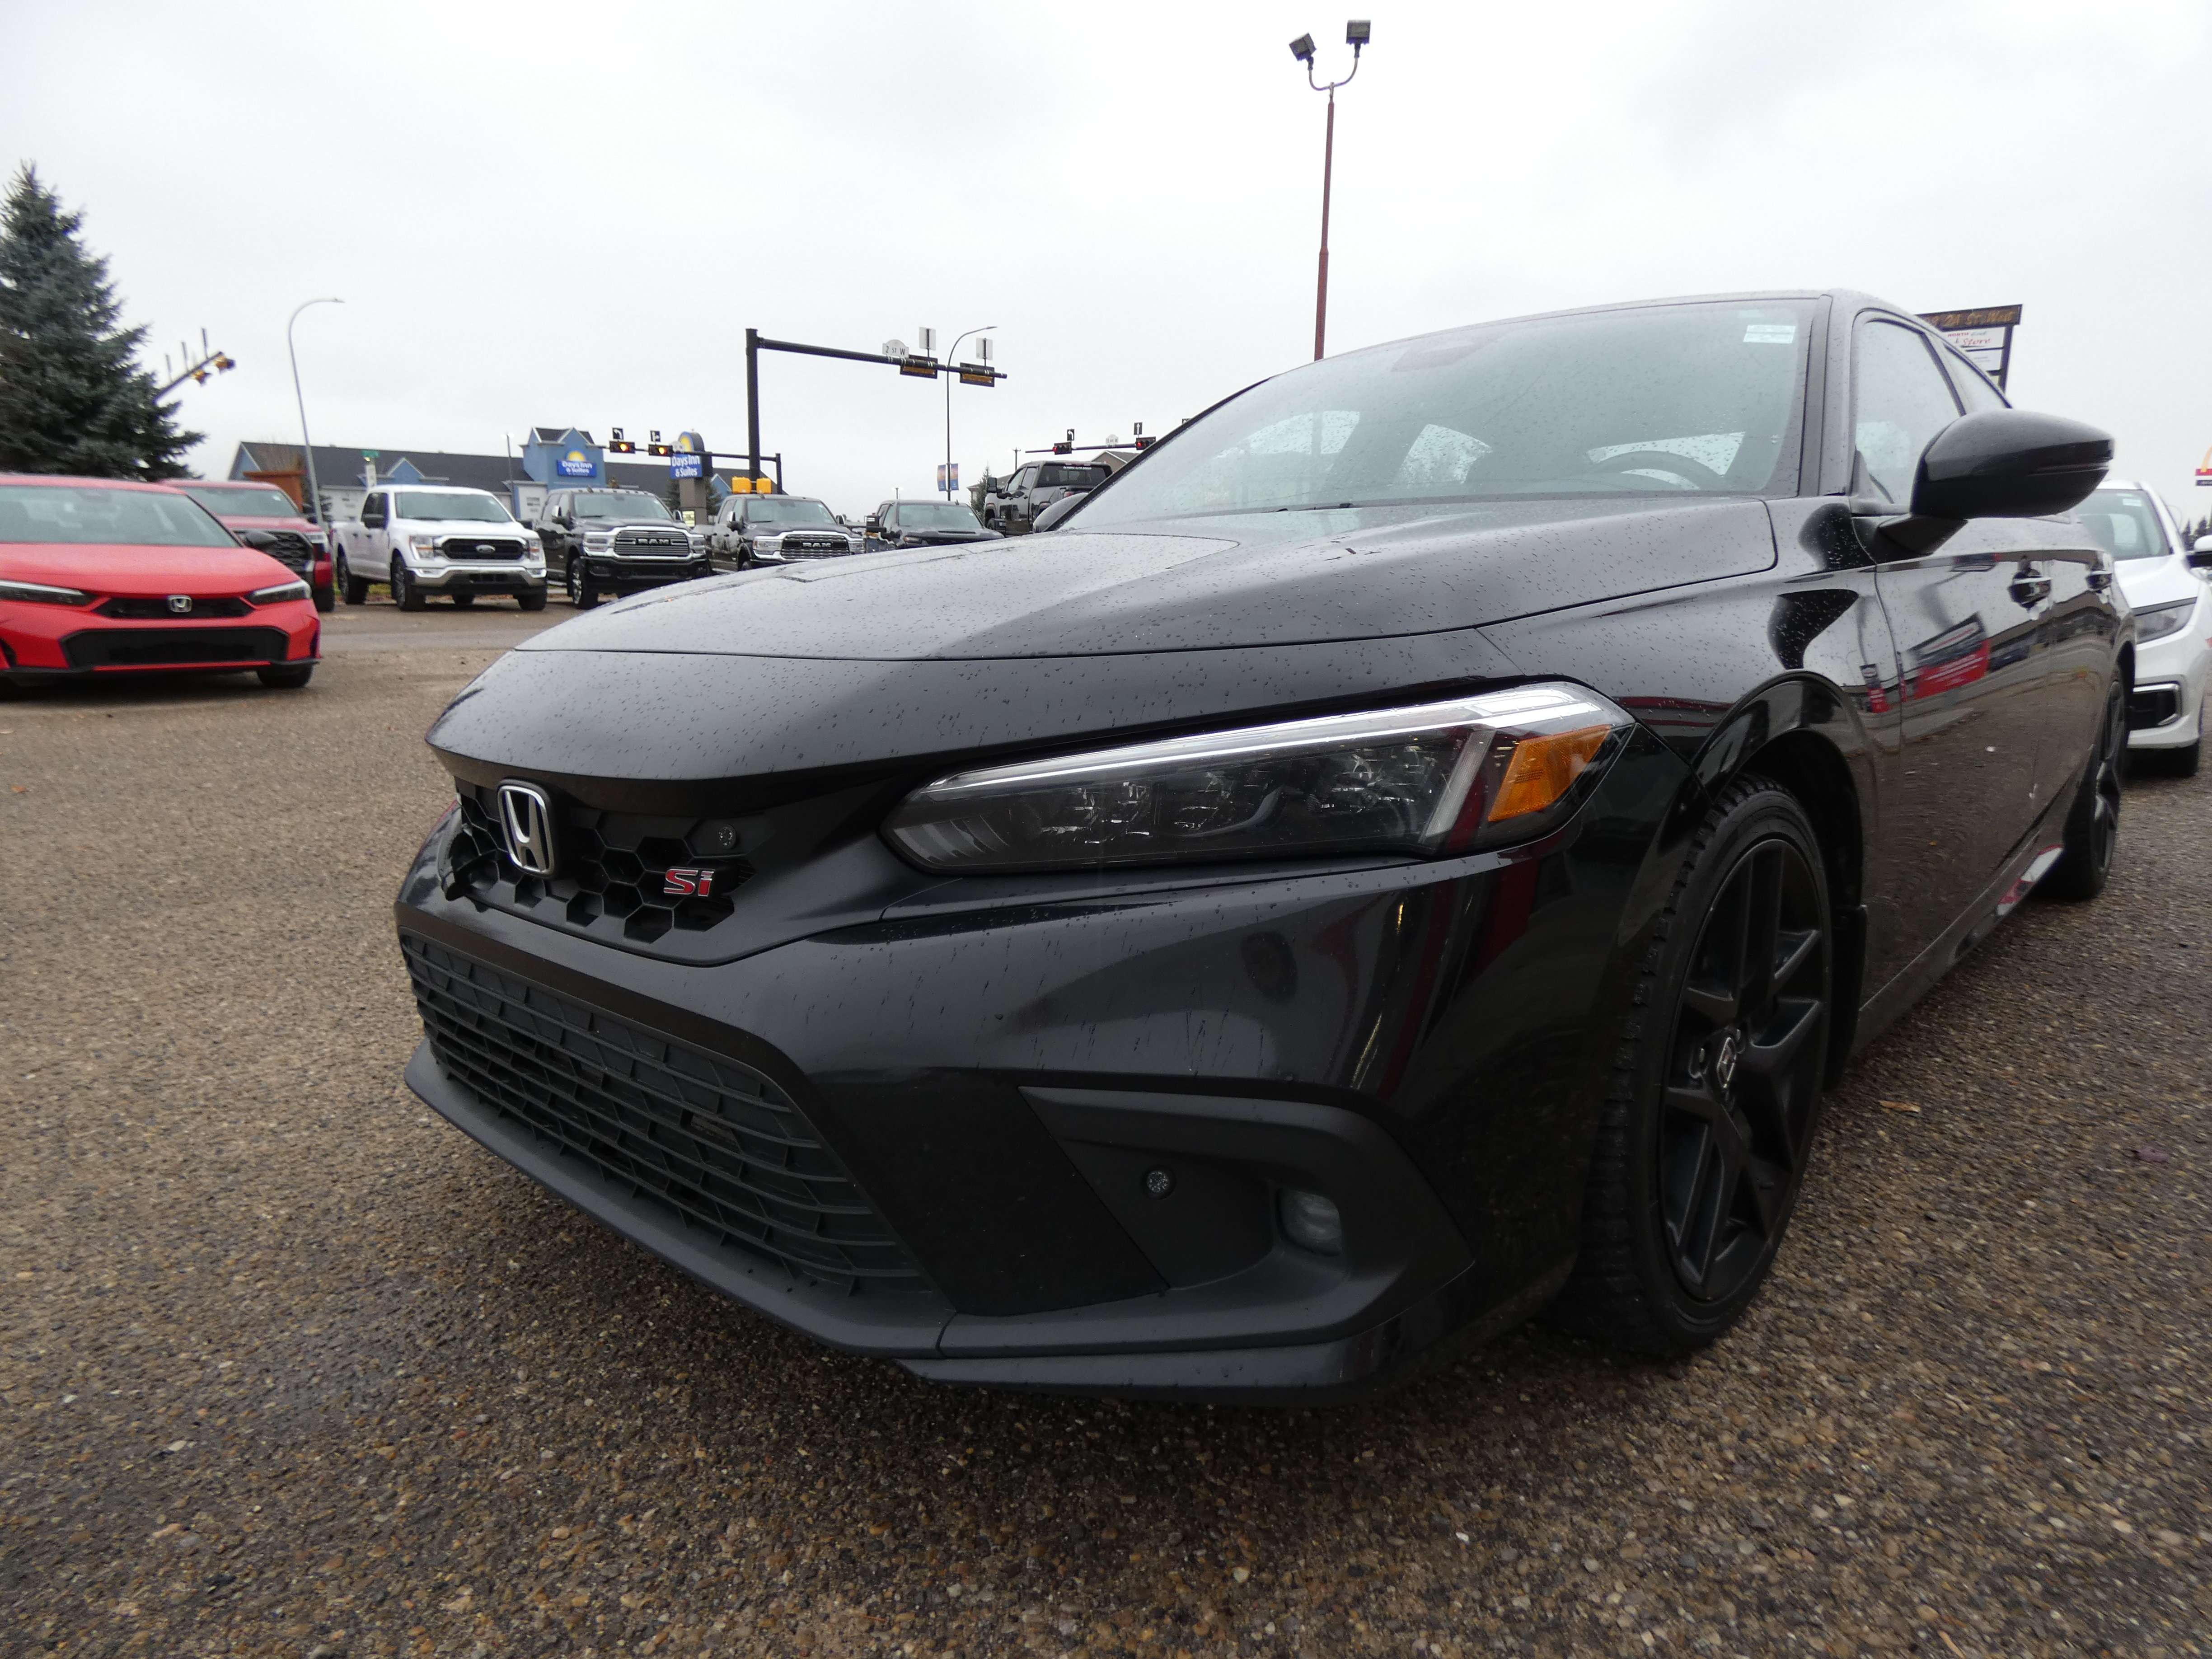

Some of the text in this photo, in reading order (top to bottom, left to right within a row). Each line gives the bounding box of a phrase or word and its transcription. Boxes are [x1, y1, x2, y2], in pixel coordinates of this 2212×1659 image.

[672, 455, 700, 468] Days Inn
[680, 467, 698, 477] Suites
[663, 867, 716, 897] Si
